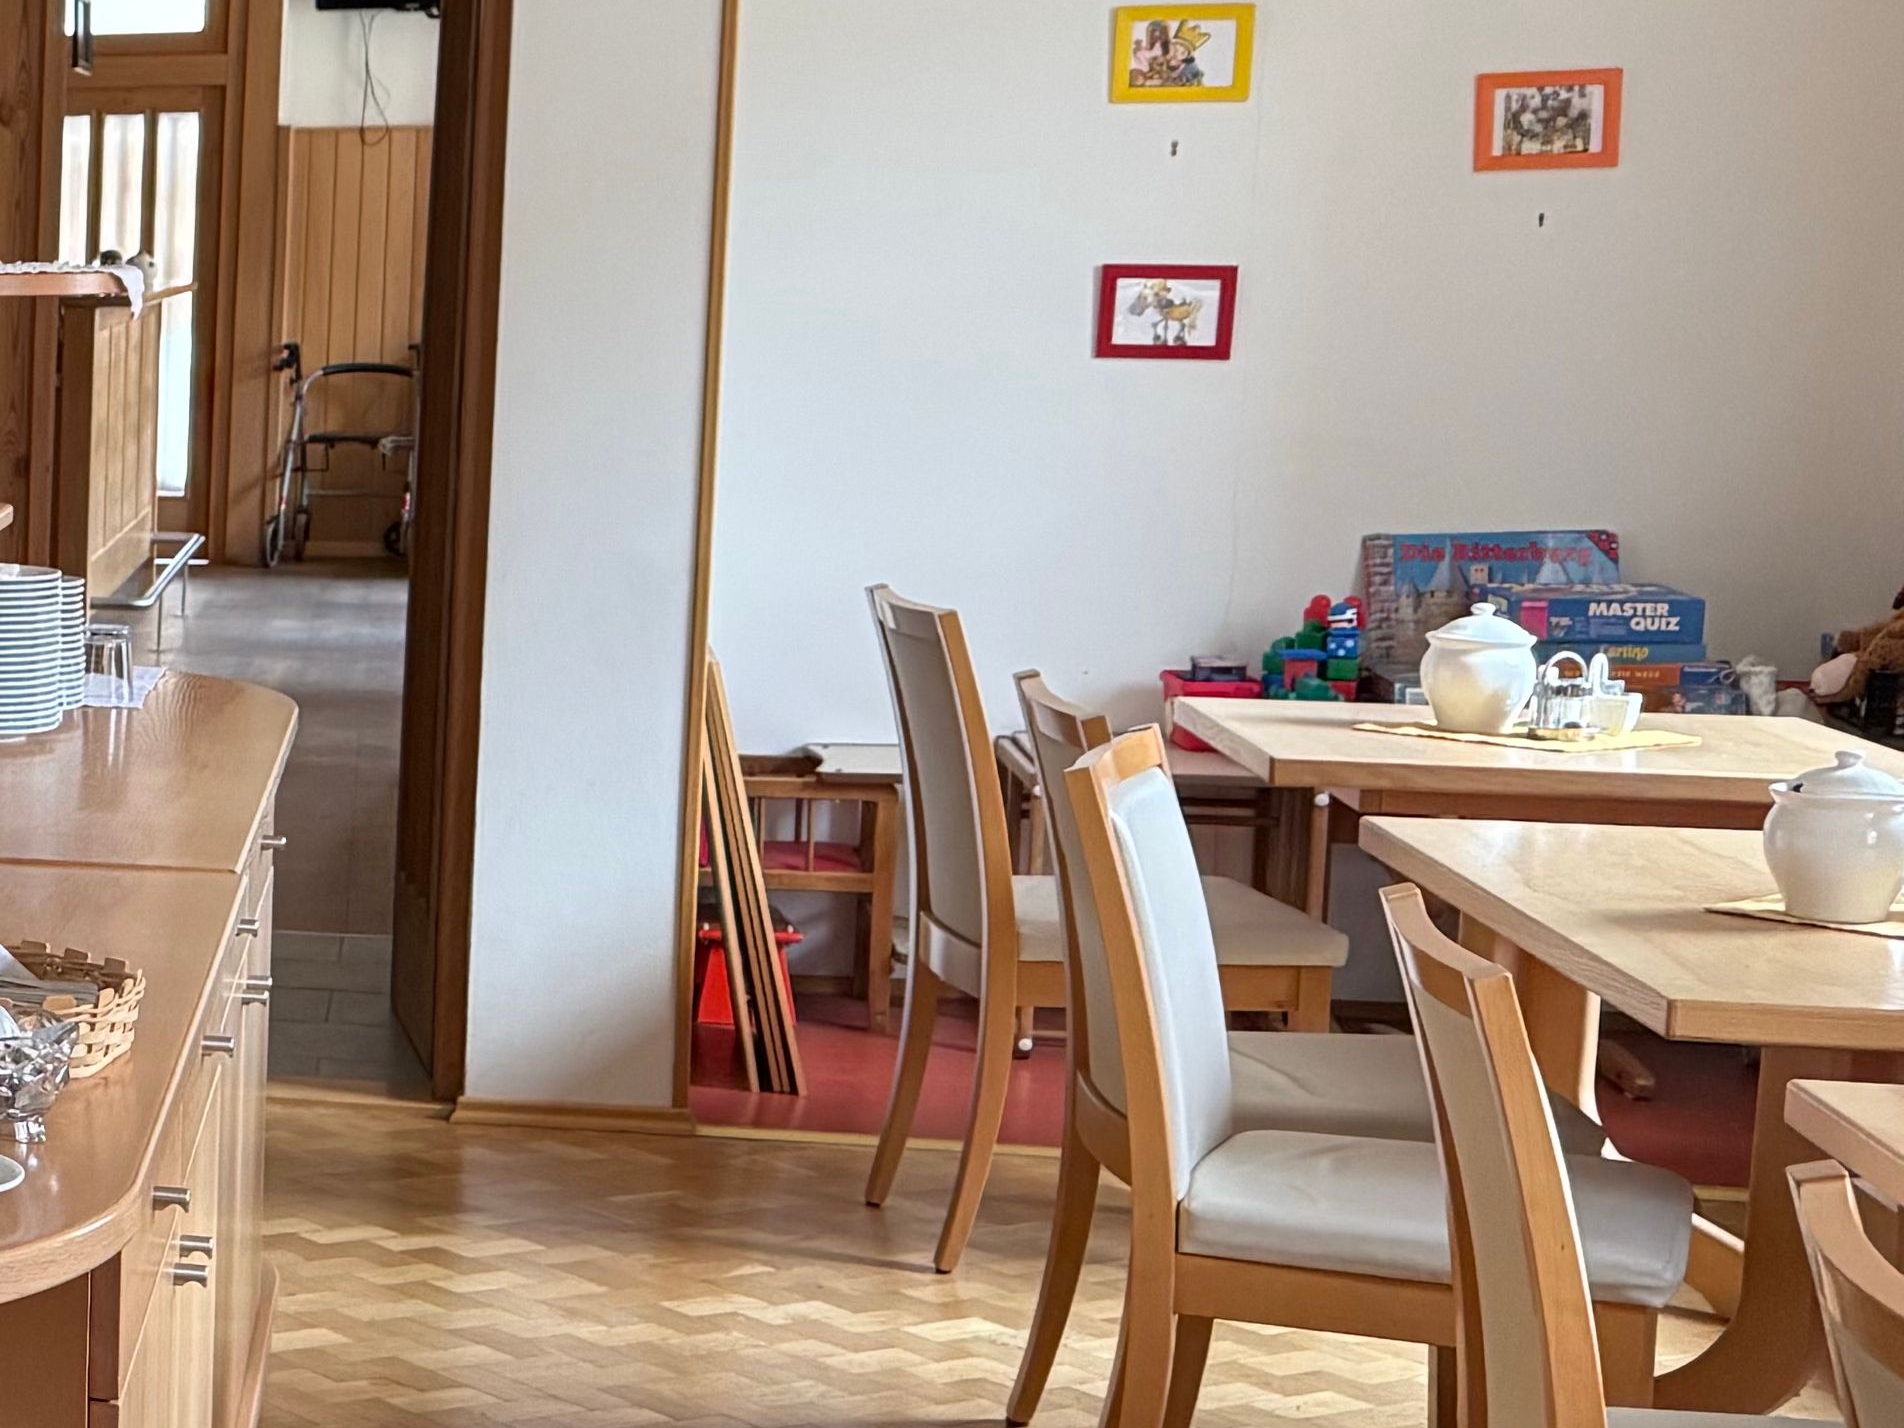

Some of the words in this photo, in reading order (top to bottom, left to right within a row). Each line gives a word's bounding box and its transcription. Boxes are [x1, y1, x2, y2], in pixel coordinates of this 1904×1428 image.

[1400, 542, 1445, 562] Die
[1588, 602, 1669, 617] MASTER
[1629, 616, 1680, 631] QUIZ
